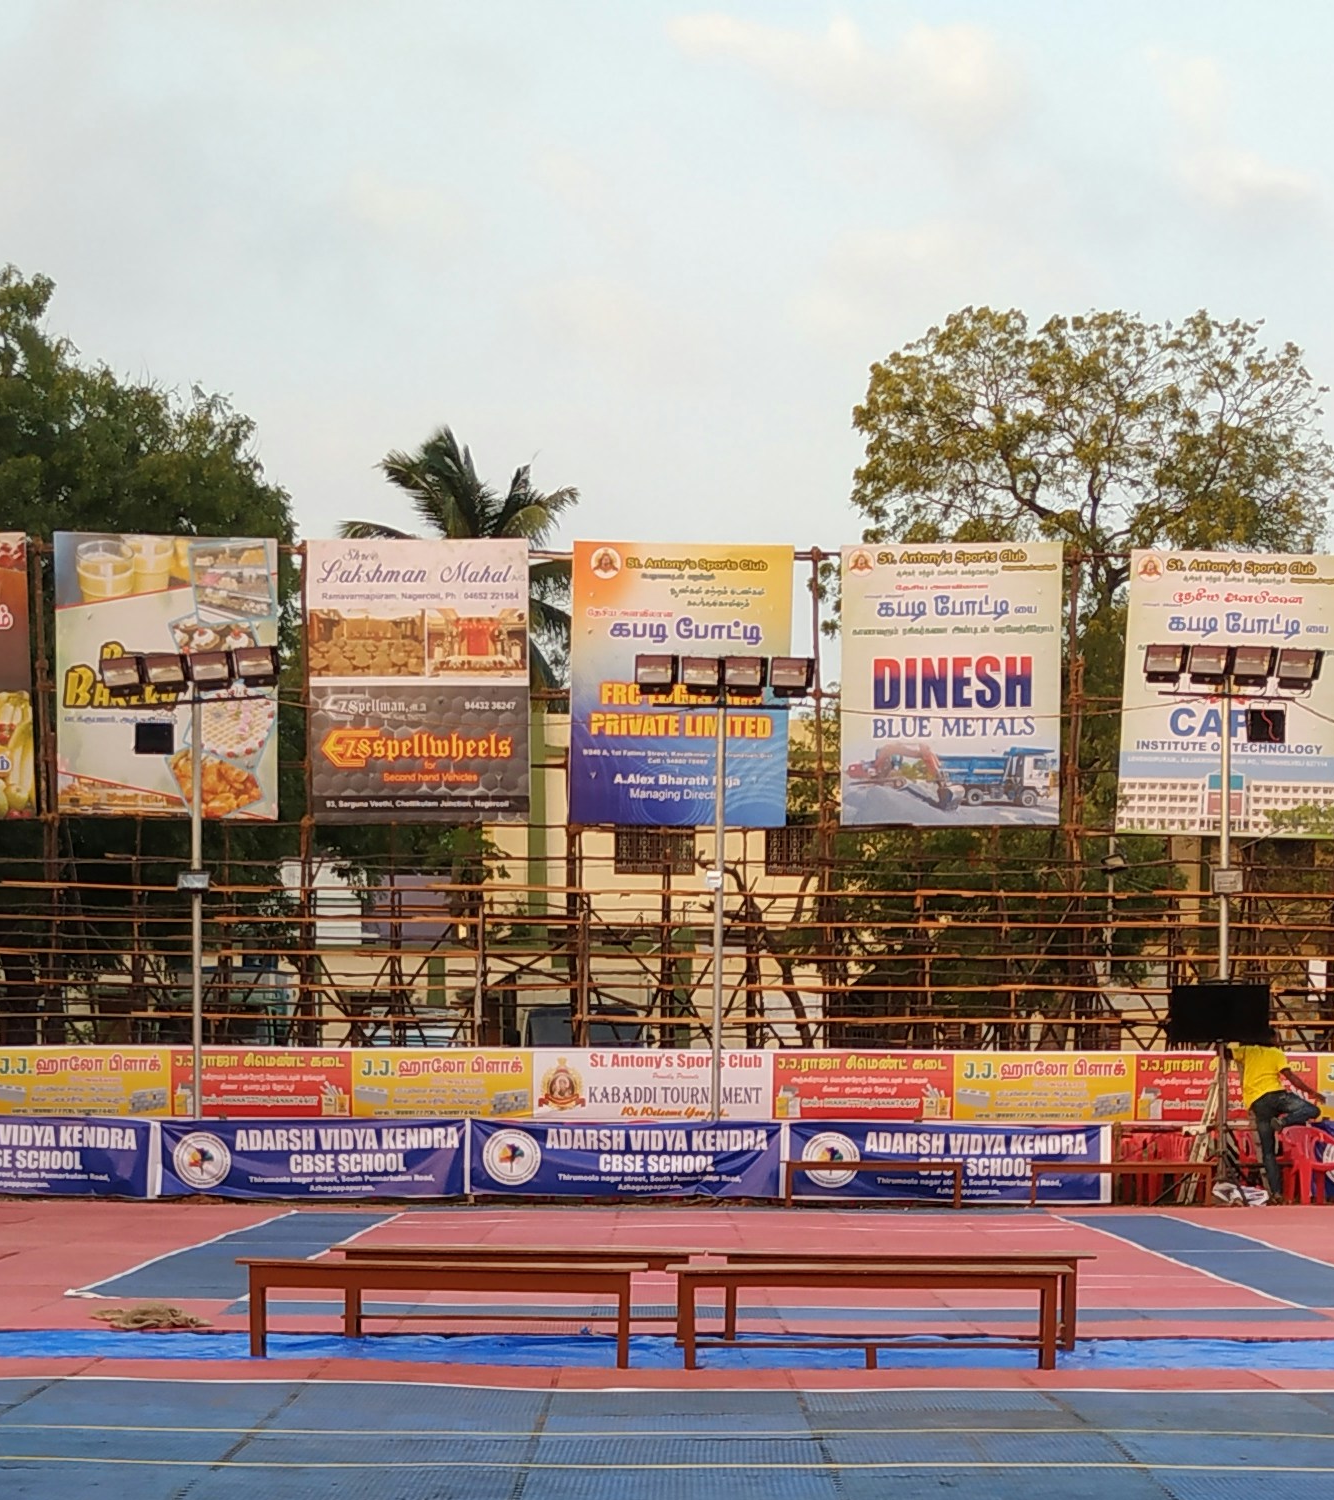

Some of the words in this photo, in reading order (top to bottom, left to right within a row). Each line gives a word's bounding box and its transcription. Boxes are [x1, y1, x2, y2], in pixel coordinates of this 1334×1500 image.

[626, 557, 643, 569] St.
[645, 557, 696, 571] Antony's
[698, 559, 737, 571] Sports
[739, 560, 768, 571] Club
[877, 552, 896, 565] St.
[900, 550, 952, 567] Antony's
[955, 551, 996, 566] Sports
[1000, 549, 1027, 563] Club
[1166, 559, 1186, 571] St.
[1189, 560, 1241, 576] Antony's
[1244, 560, 1286, 576] Sports
[1289, 561, 1317, 575] Club
[317, 559, 427, 584] Lakshman
[440, 560, 513, 584] Mahal
[877, 600, 927, 622] கபடி
[934, 595, 1009, 622] போட்டி
[610, 621, 668, 643] கபடி
[676, 617, 762, 645] போட்டி
[1168, 615, 1218, 637] கபடி
[1226, 612, 1301, 640] போட்டி
[873, 656, 1033, 709] DINESH
[590, 713, 680, 737] PRIVATE
[873, 718, 931, 739] BLUE
[942, 715, 1035, 737] METALS
[1136, 740, 1207, 751] INSTITUTE
[1233, 743, 1323, 755] TECHNOLOGY
[383, 773, 416, 782] Second
[418, 773, 440, 782] hand
[442, 773, 478, 782] Vehicles
[658, 774, 708, 786] Bharath
[630, 789, 681, 801] Managing
[471, 1056, 523, 1074] பிளாக்
[590, 1053, 607, 1068] St.
[611, 1053, 673, 1070] Antony's
[729, 1053, 762, 1068] Club
[846, 1055, 908, 1070] சிமெண்ட்
[588, 1086, 657, 1105] KABADDI
[661, 1086, 762, 1105] TOURNMENT
[621, 1107, 637, 1116] We
[640, 1107, 681, 1116] Welcome
[684, 1107, 705, 1119] You
[59, 1126, 137, 1150] KENDRA
[235, 1129, 315, 1151] ADARSH
[318, 1129, 378, 1150] VIDYA
[382, 1128, 459, 1149] KENDRA
[546, 1128, 624, 1150] ADARSH
[628, 1129, 688, 1151] VIDYA
[692, 1130, 768, 1151] KENDRA
[865, 1132, 945, 1154] ADARSH
[949, 1133, 1006, 1155] VIDYA
[1009, 1133, 1087, 1155] KENDRA
[15, 1150, 82, 1170] SCHOOL
[289, 1153, 335, 1173] CBSE
[338, 1153, 406, 1172] SCHOOL
[599, 1154, 645, 1173] CBSE
[18, 1171, 39, 1179] South
[342, 1175, 363, 1183] South
[623, 1174, 647, 1183] street,
[649, 1174, 671, 1183] South
